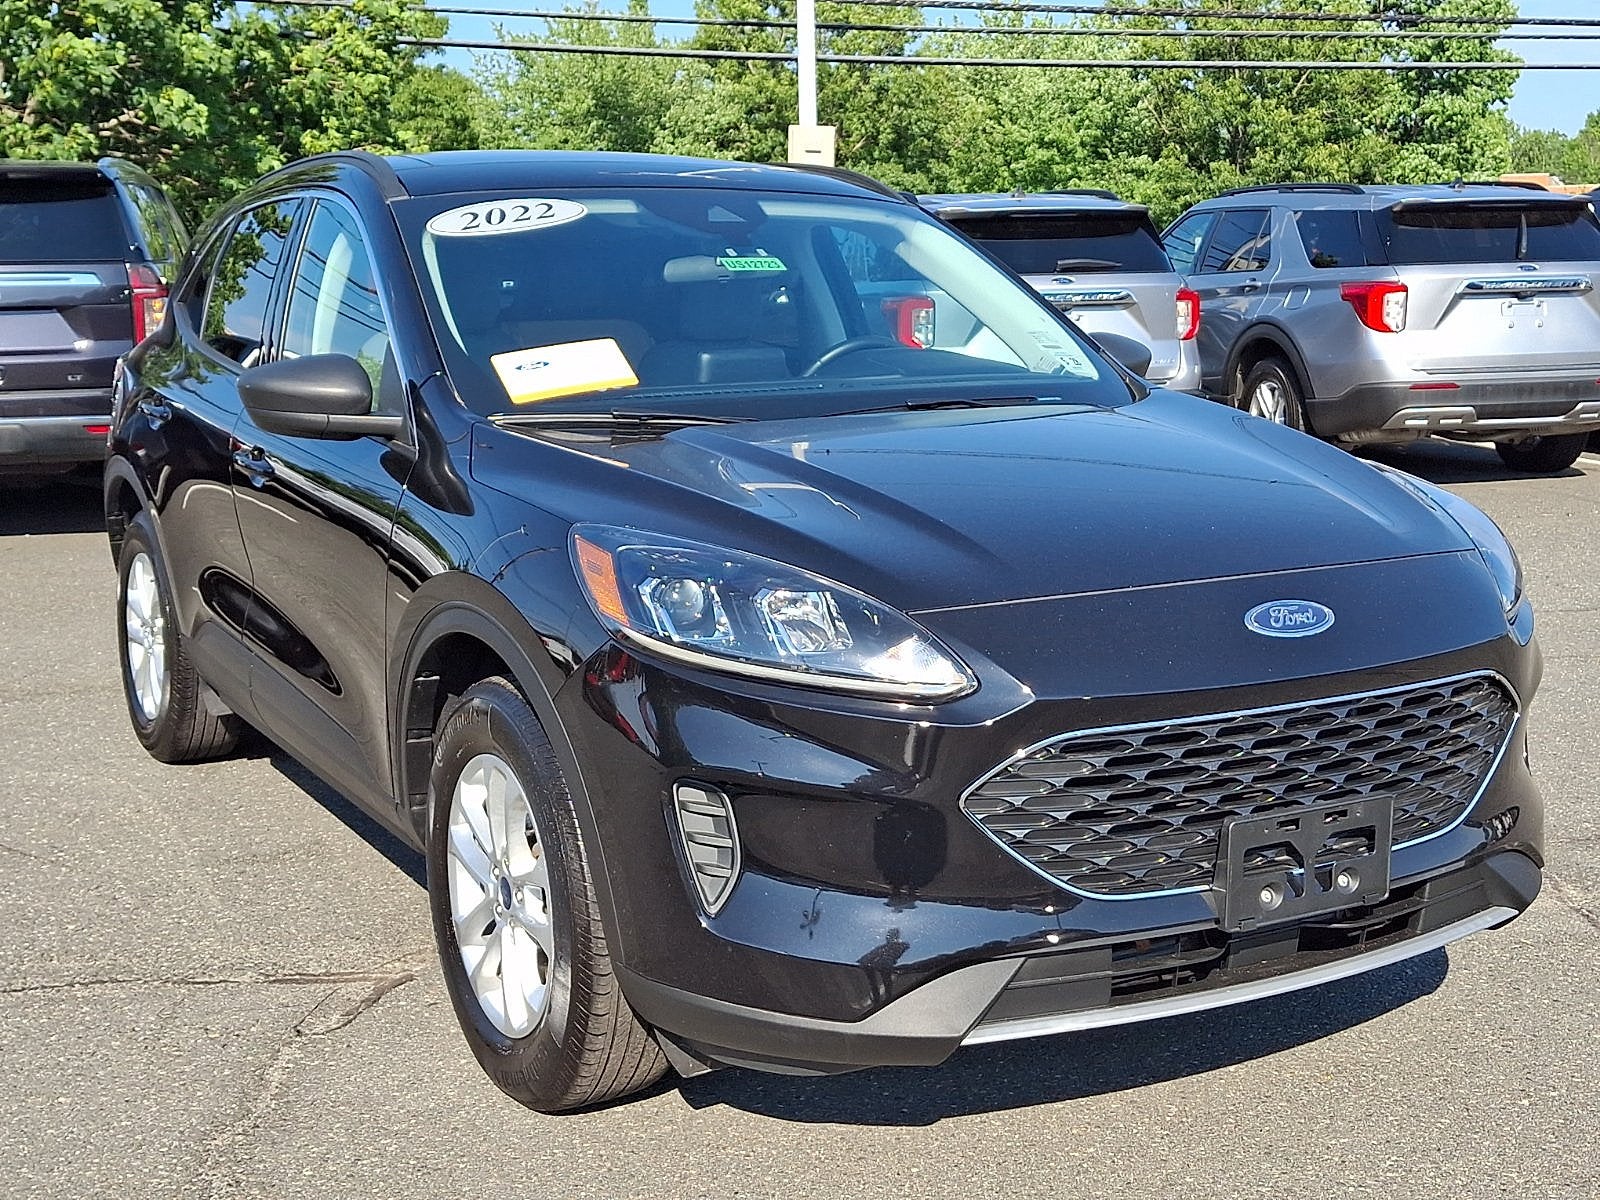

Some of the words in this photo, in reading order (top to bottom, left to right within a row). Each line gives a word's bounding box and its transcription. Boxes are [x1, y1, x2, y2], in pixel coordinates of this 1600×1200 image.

[459, 202, 556, 231] 2022
[724, 259, 781, 269] US12723
[1269, 605, 1317, 628] Ford
